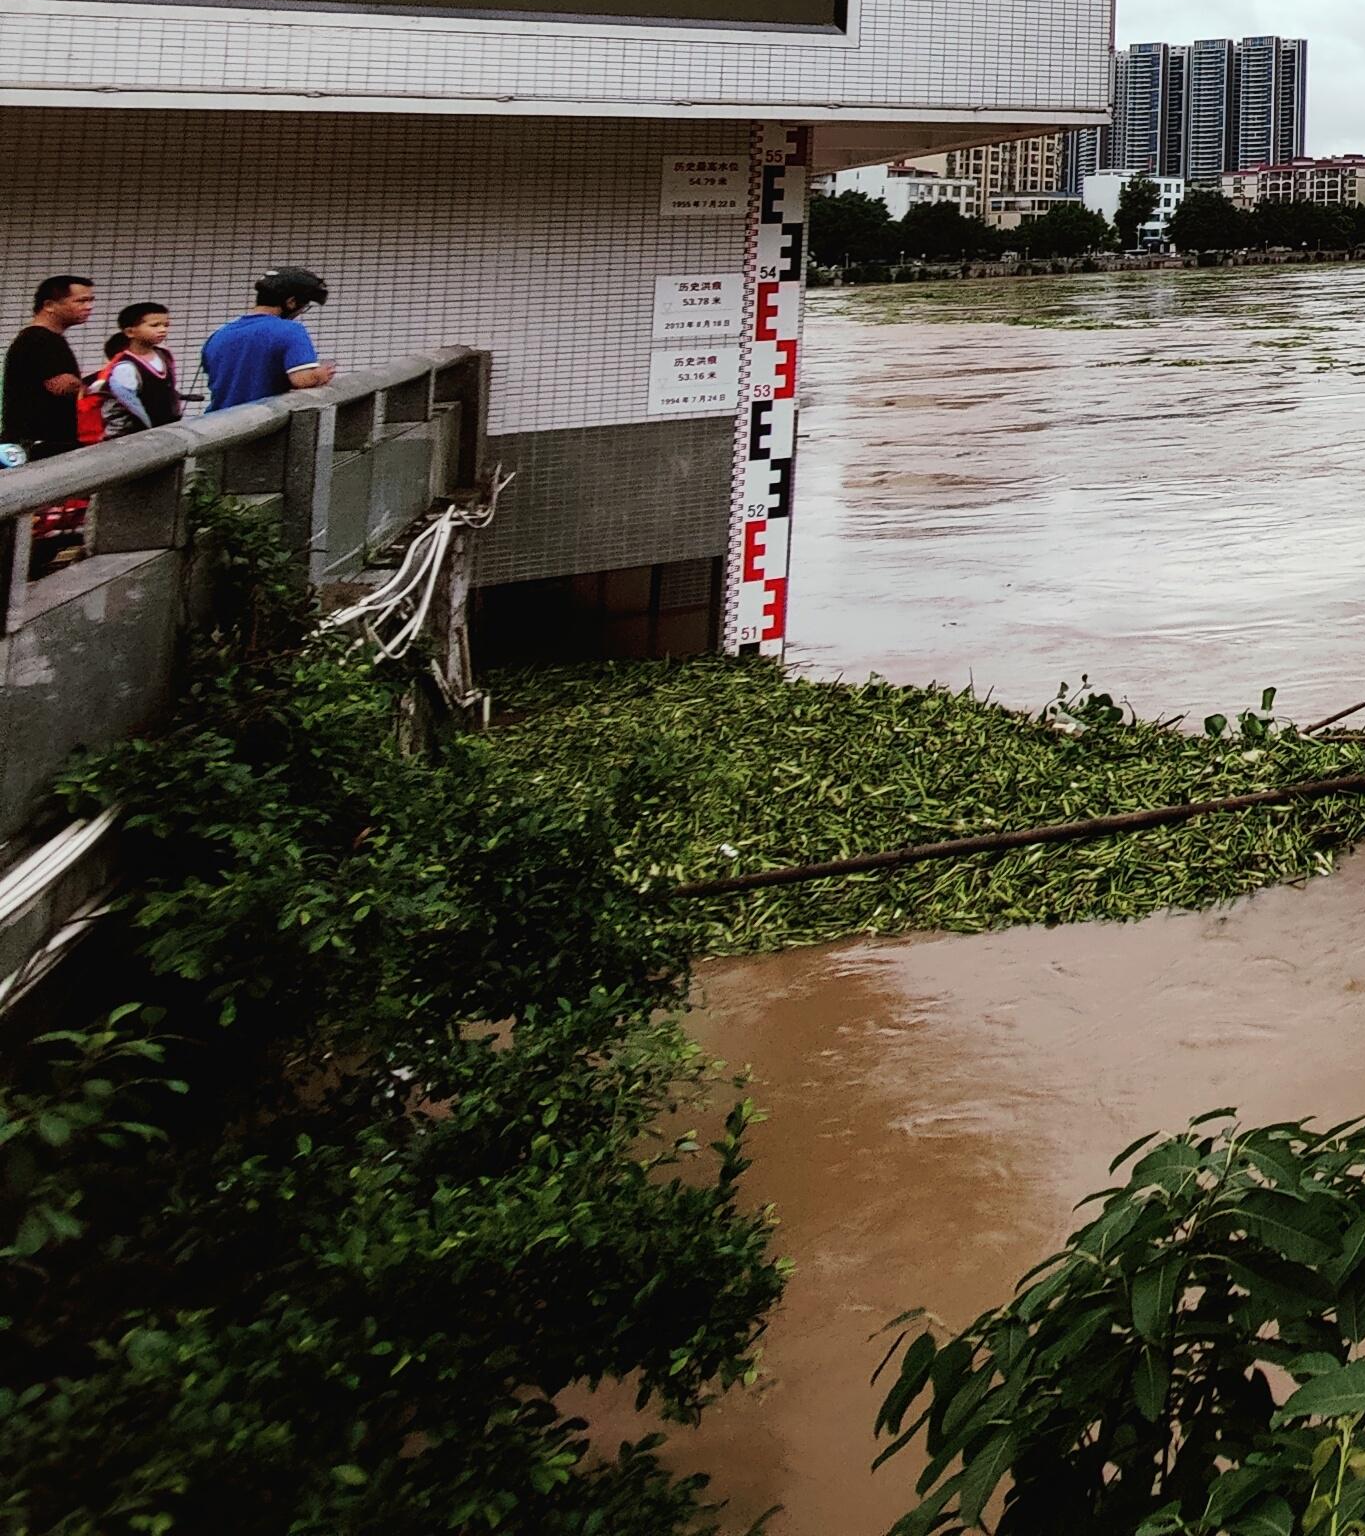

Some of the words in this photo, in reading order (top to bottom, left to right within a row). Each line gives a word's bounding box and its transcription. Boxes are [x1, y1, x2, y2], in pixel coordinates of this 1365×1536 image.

[765, 149, 783, 163] 55
[759, 266, 777, 279] 54
[753, 384, 771, 398] 53
[747, 504, 765, 518] 52
[741, 626, 757, 640] 51
